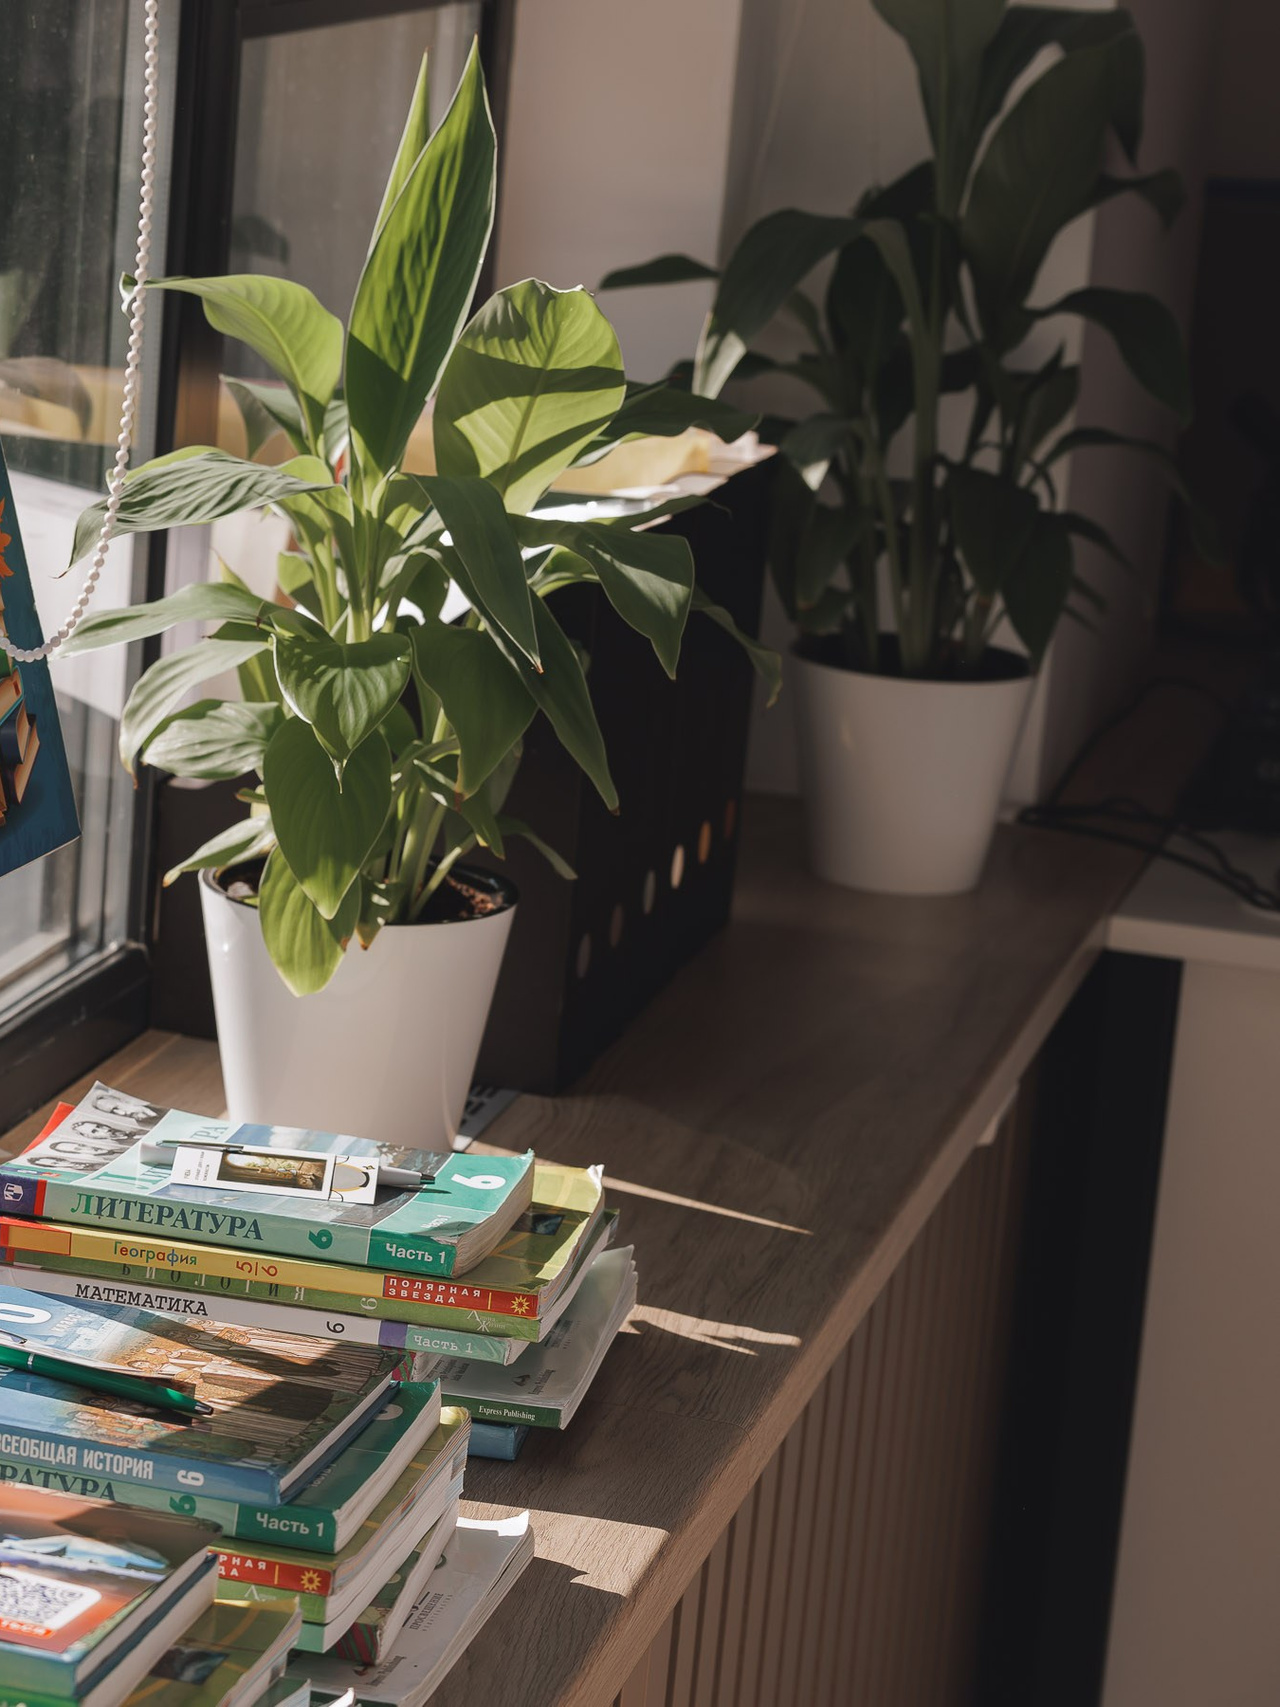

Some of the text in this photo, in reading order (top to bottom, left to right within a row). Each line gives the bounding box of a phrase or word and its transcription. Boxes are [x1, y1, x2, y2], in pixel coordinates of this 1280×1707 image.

[70, 1192, 263, 1241] ЛИТЕРАТУРА
[114, 1241, 197, 1266] География
[386, 1243, 446, 1264] Часть 1
[388, 1288, 456, 1304] ЗВЕЗДА
[389, 1278, 481, 1298] ПОЛЯРНАЯ
[74, 1284, 209, 1316] МАТЕМАТИКА
[413, 1334, 474, 1353] Часть 1
[479, 1405, 536, 1420] Express Publishing
[83, 1452, 154, 1480] ИСТОРИЯ
[255, 1512, 324, 1537] Часть 1
